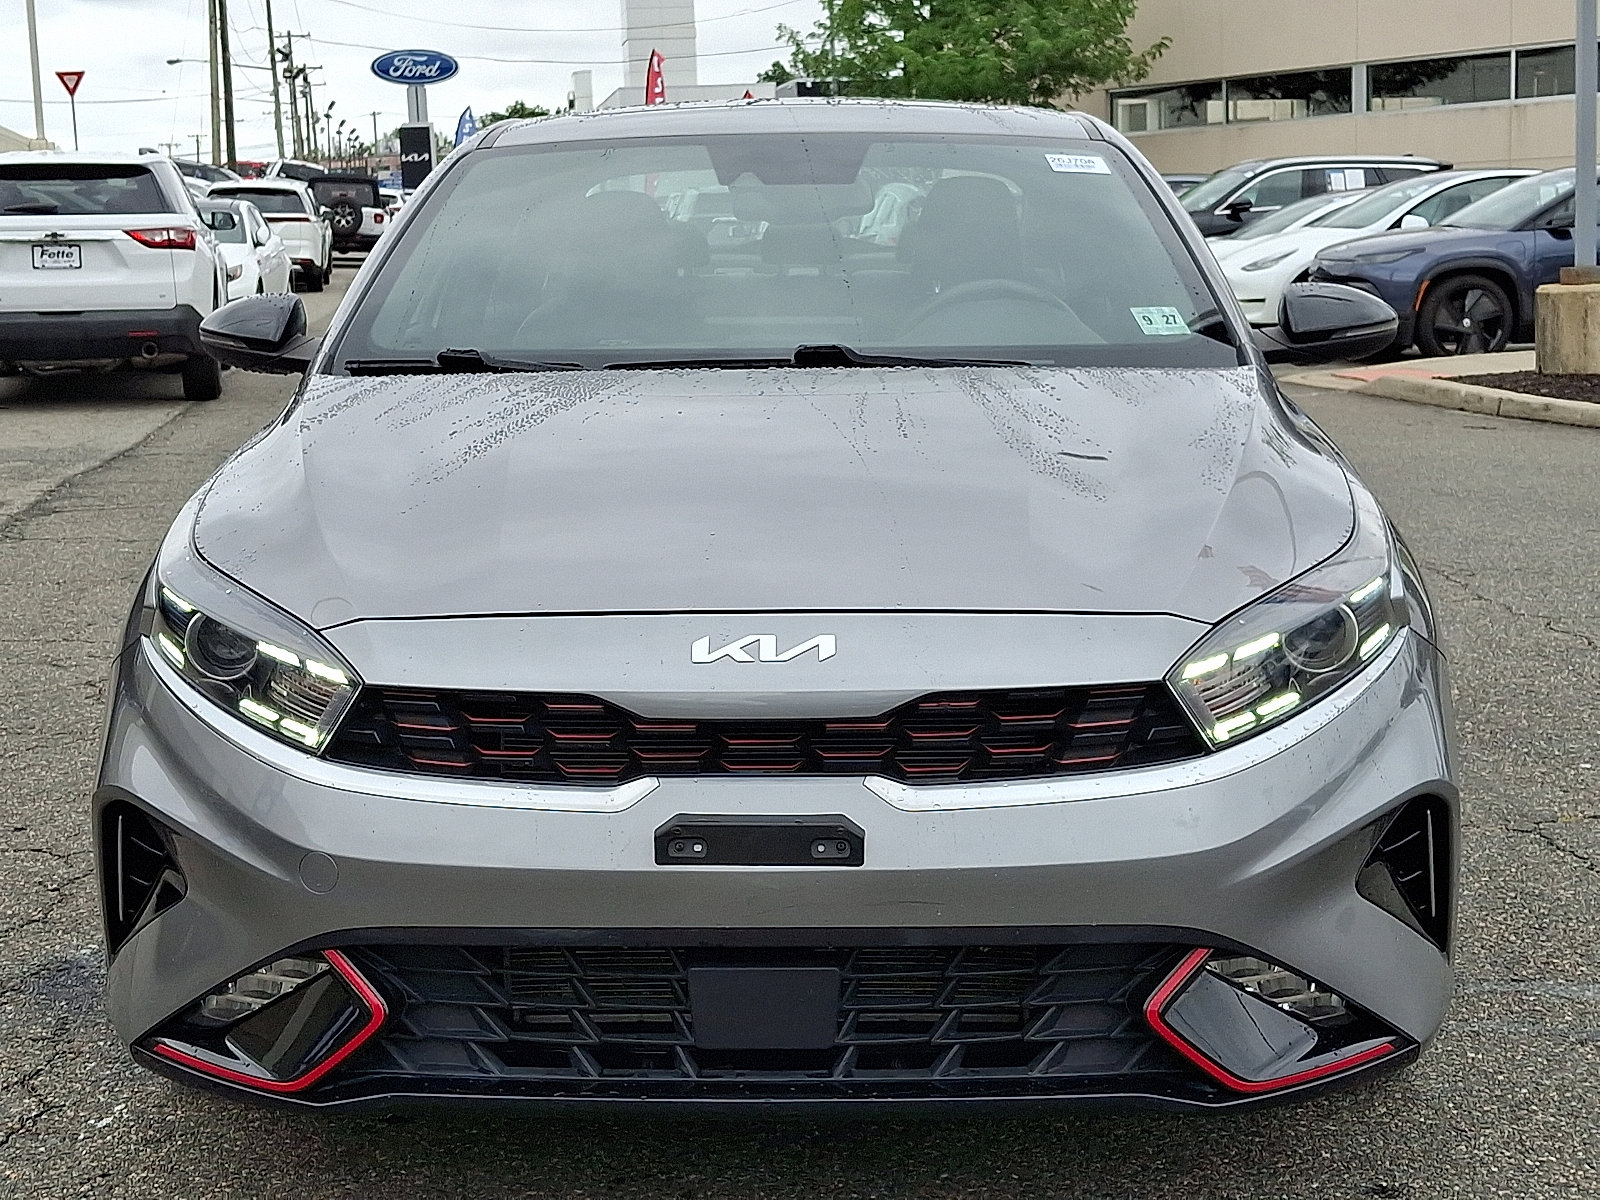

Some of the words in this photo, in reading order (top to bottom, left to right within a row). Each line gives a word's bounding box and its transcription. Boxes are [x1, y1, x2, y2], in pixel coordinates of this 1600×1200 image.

[389, 55, 441, 77] Ford
[401, 153, 430, 162] KIA
[1142, 315, 1153, 326] 9
[1161, 314, 1178, 325] 27
[691, 634, 837, 664] KIA
